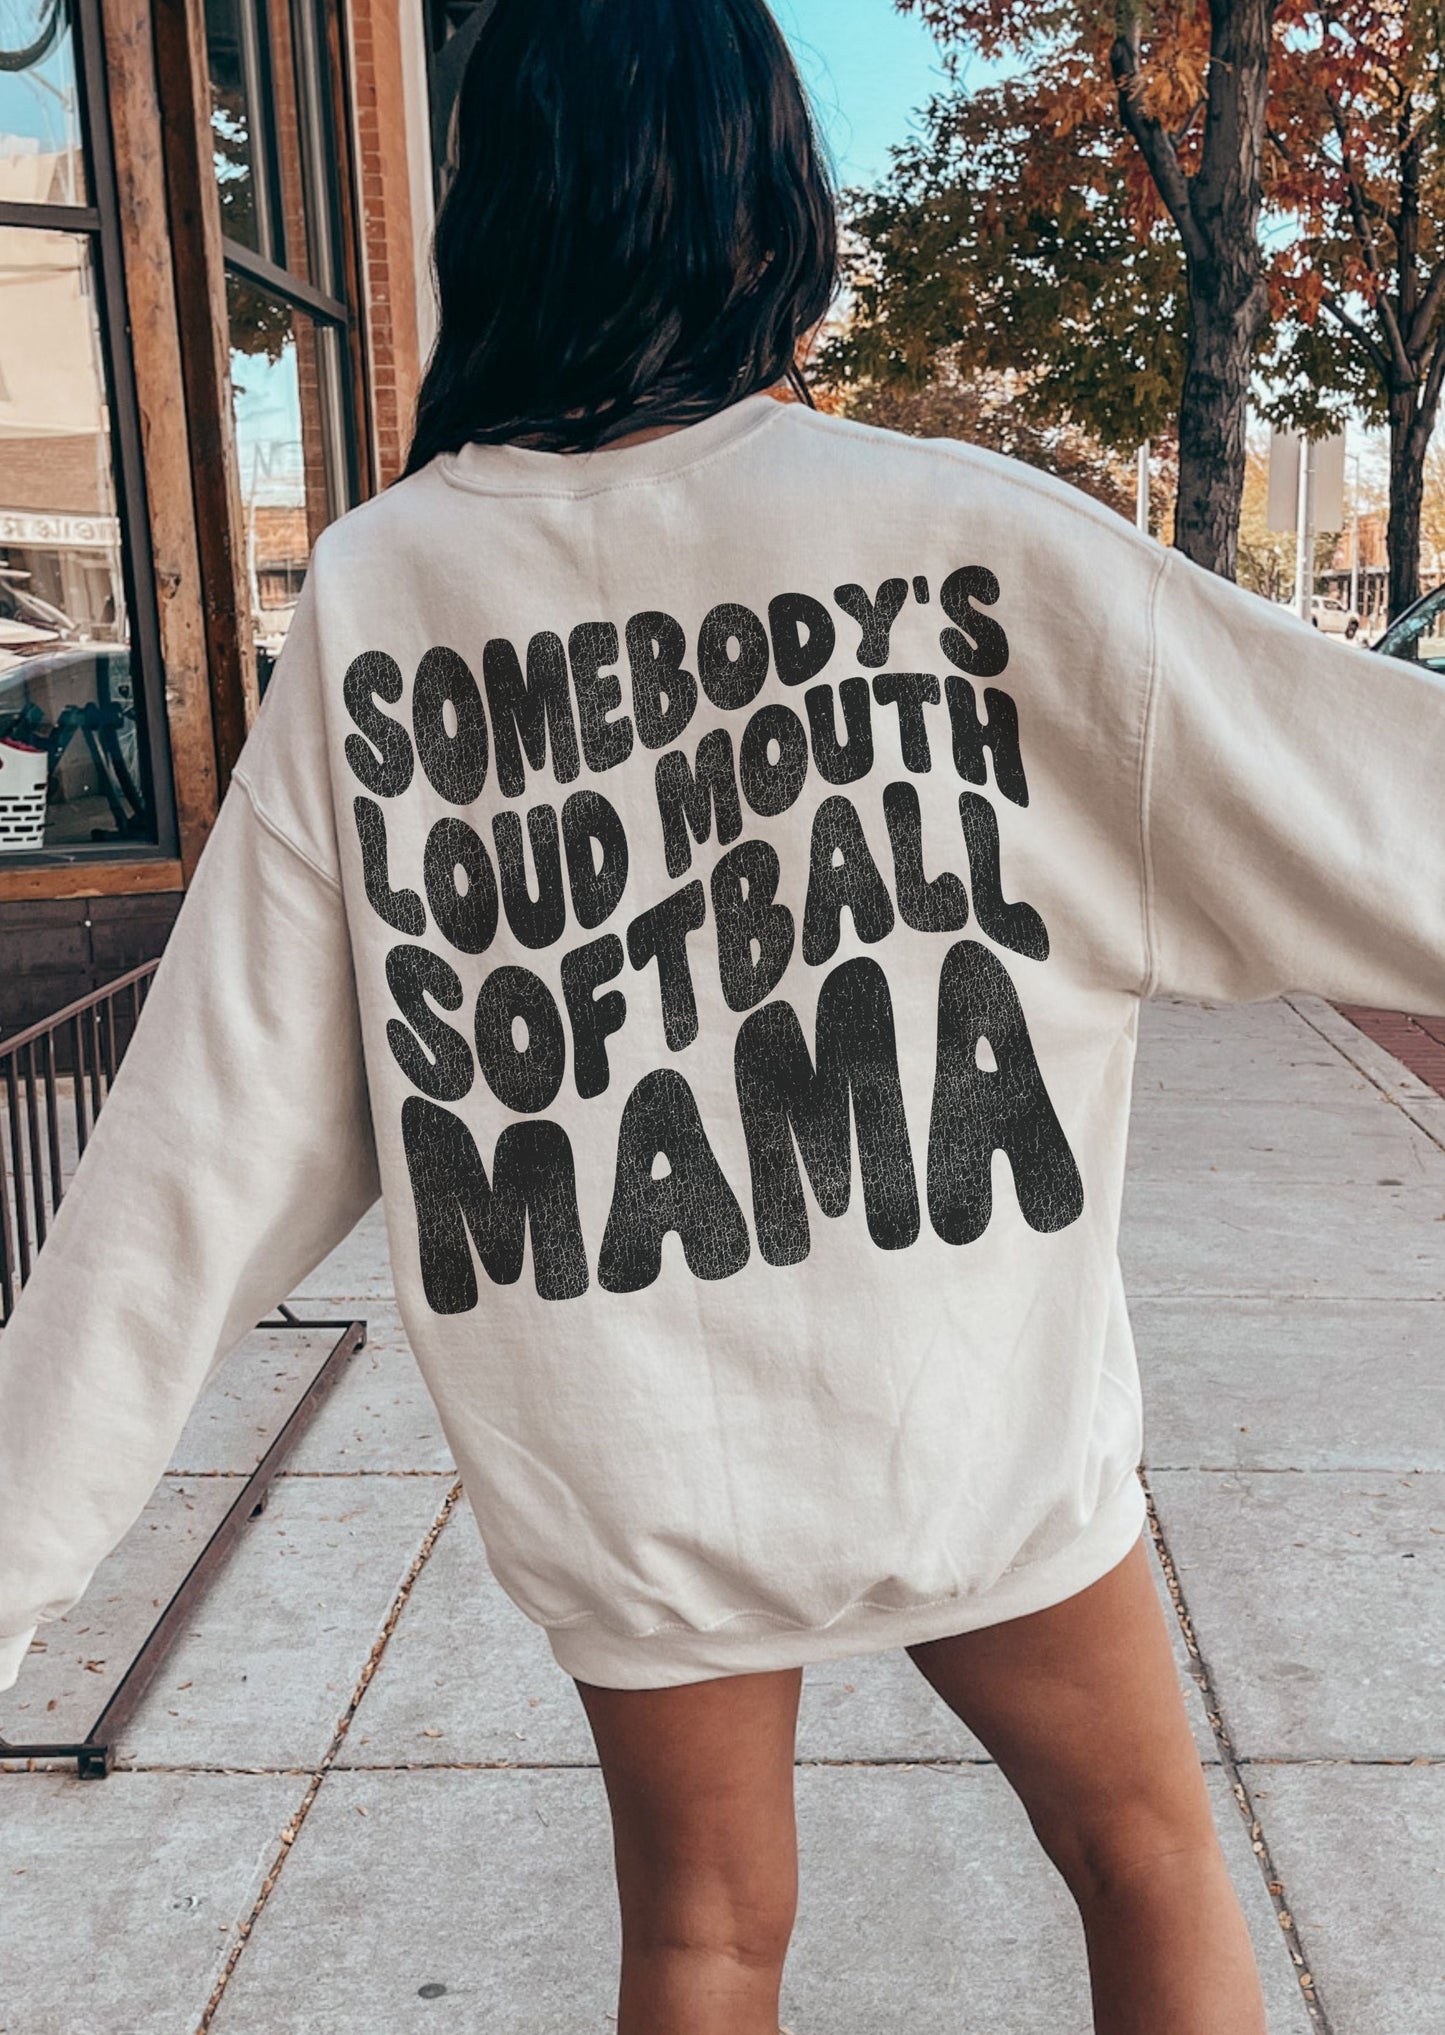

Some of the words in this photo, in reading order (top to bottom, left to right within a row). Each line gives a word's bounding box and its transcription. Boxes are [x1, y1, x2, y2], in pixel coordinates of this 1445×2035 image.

[343, 565, 1010, 805] SOMEBODY'S
[354, 790, 629, 955] LOUD
[655, 673, 1030, 880] MOUTH
[386, 782, 1050, 1114] SOFTBALL
[401, 940, 1085, 1315] MAMA
